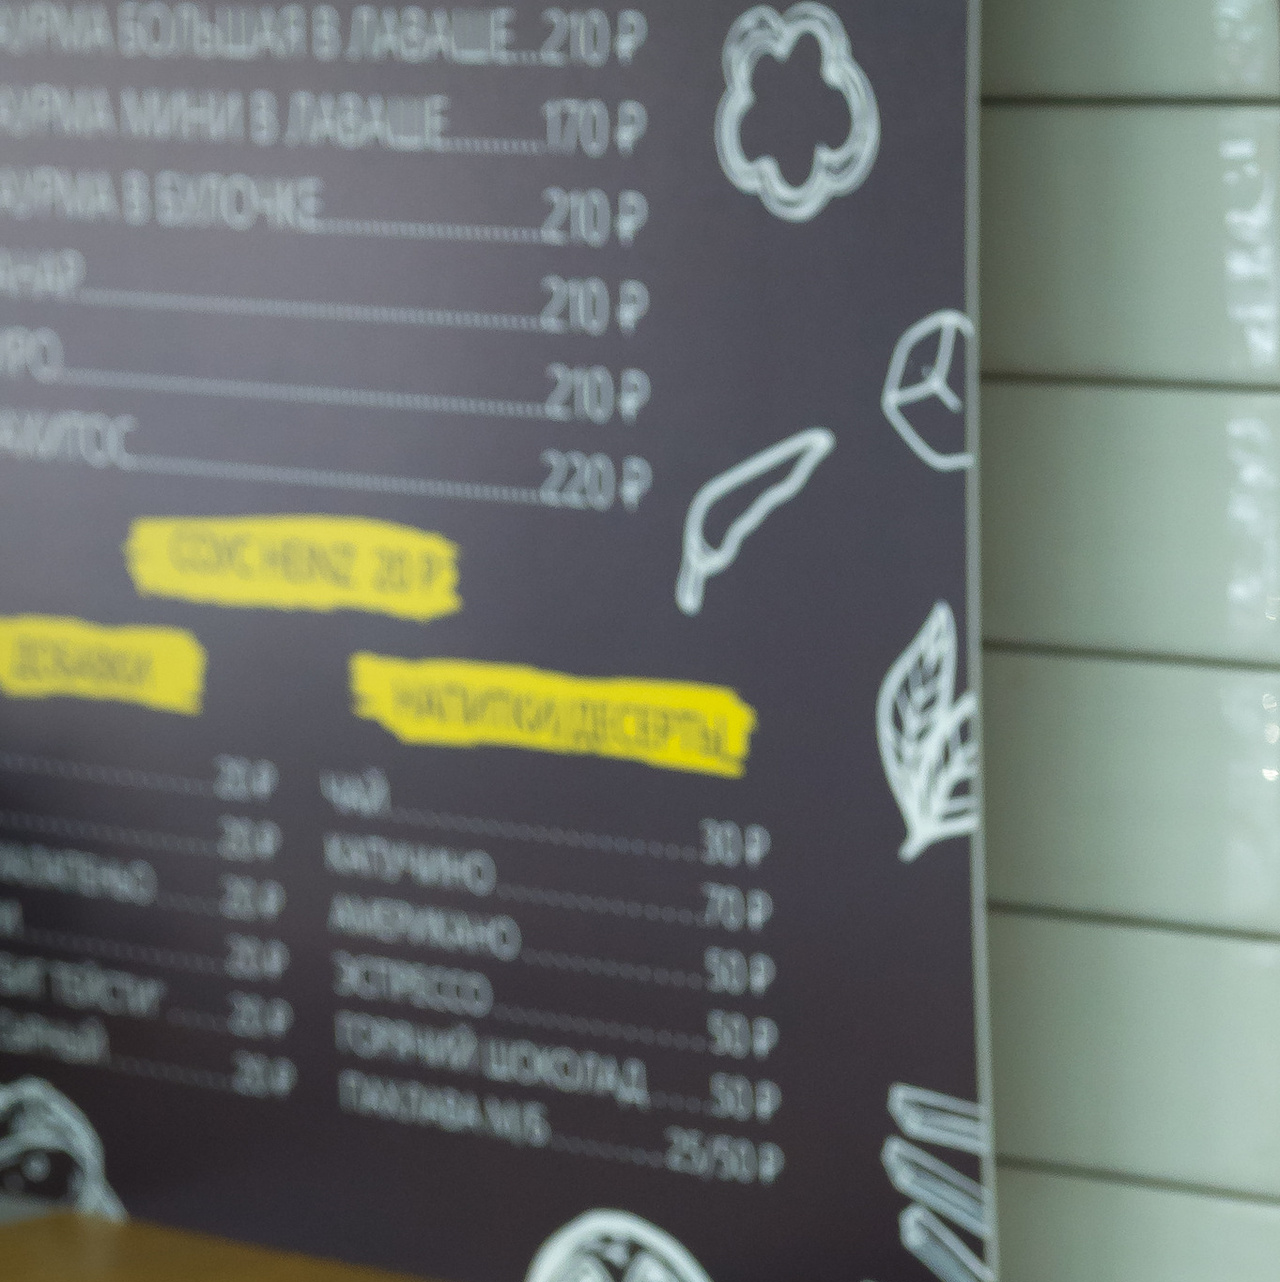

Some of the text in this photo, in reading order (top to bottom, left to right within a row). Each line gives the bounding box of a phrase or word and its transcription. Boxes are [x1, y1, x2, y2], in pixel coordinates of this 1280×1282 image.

[121, 6, 302, 60] БОЛЬШАЯ
[314, 8, 340, 62] В
[347, 6, 514, 63] ЛАВАШЕ
[540, 8, 610, 66] 210
[121, 89, 243, 141] МИНИ
[250, 89, 277, 146] В
[285, 90, 449, 149] ЛАВАШЕ
[541, 98, 610, 157] 170
[123, 169, 148, 226] В
[155, 170, 322, 232] БУЛОЧКЕ
[540, 187, 610, 247] 210
[541, 277, 610, 336] 210
[546, 364, 613, 424] 210
[541, 450, 614, 511] 220
[321, 768, 388, 815] ЧАЙ
[324, 833, 495, 894] КАПУЧИНО
[701, 880, 744, 930] 70
[329, 895, 520, 958] АМЕРИКАНО
[705, 944, 747, 996] 50
[334, 952, 492, 1014] ЭСПРЕССО
[707, 1008, 749, 1058] 50
[336, 1012, 475, 1067] ГОРЯЧИЙ
[483, 1040, 648, 1108] ШОКОЛАД
[710, 1070, 751, 1120] 50
[340, 1072, 481, 1131] ПАХЛАВА
[665, 1126, 753, 1181] 25/50
